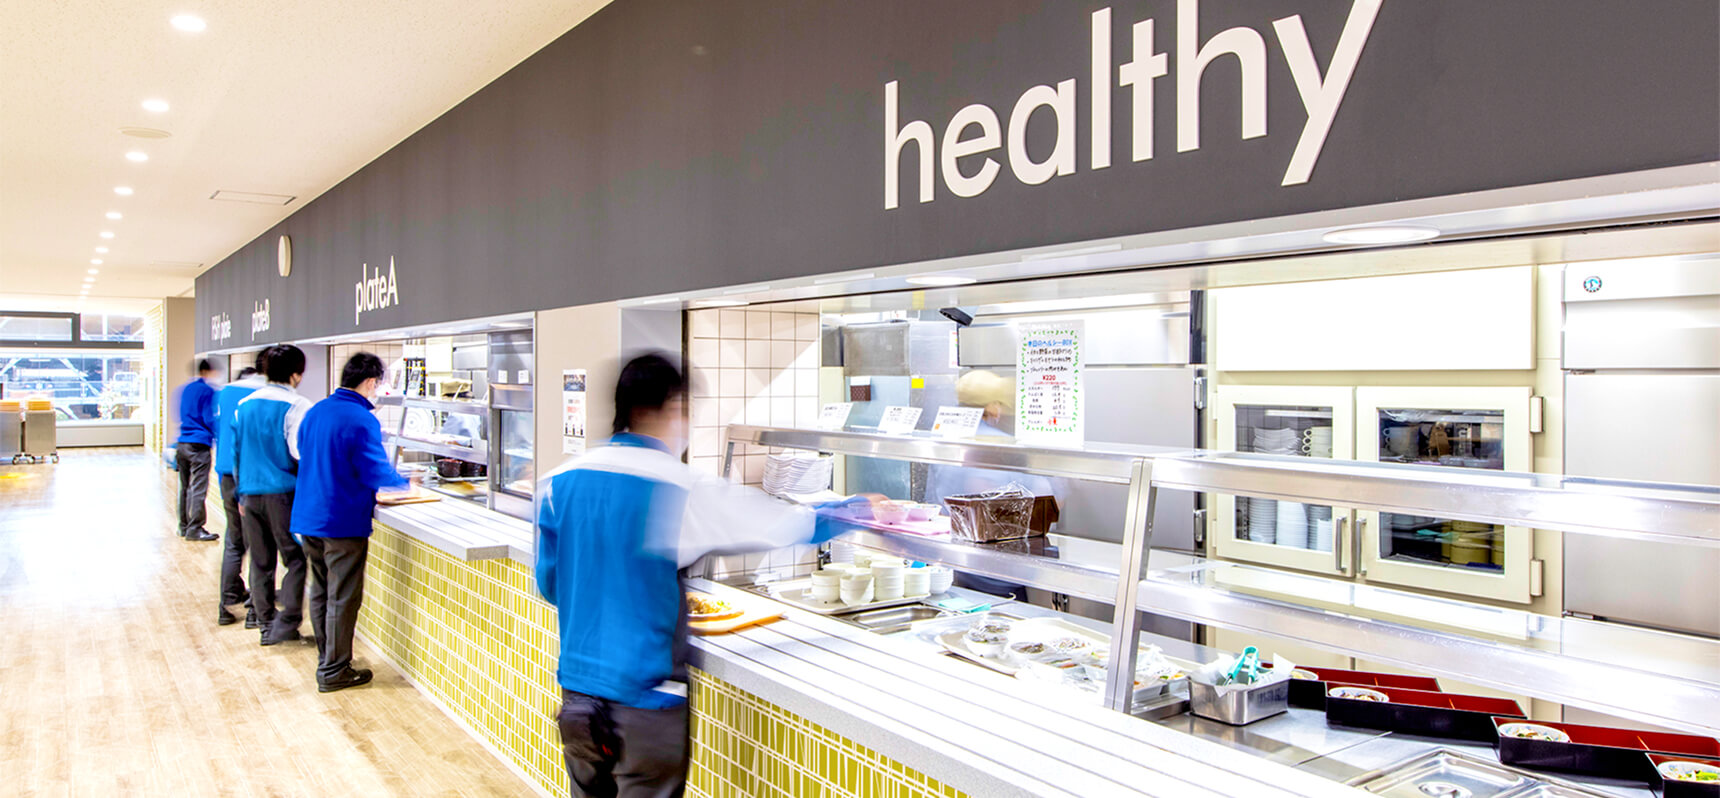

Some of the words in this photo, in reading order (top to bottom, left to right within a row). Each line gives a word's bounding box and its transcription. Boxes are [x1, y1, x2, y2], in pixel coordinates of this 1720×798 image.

[884, 0, 1385, 210] healthy
[251, 299, 270, 341] plateB
[355, 255, 399, 326] plateA
